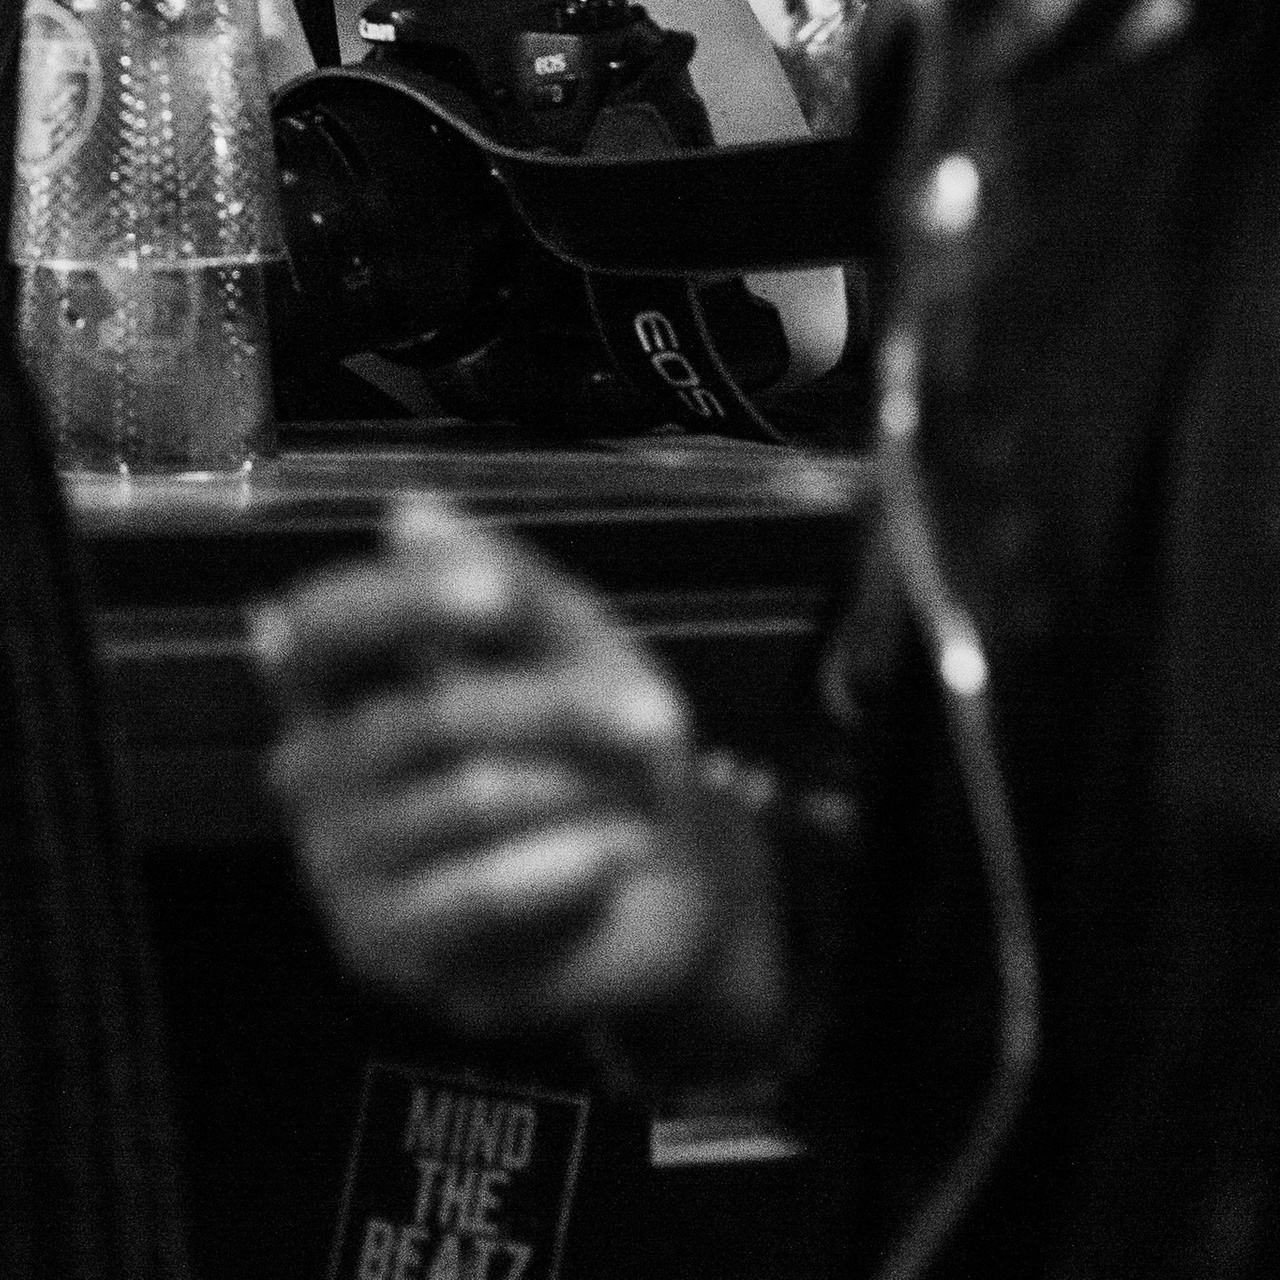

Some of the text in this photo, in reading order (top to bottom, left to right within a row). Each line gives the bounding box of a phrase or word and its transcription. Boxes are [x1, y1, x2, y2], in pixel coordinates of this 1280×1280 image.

[631, 309, 725, 419] EOS
[404, 1087, 537, 1170] MIND
[414, 1157, 510, 1234] THE
